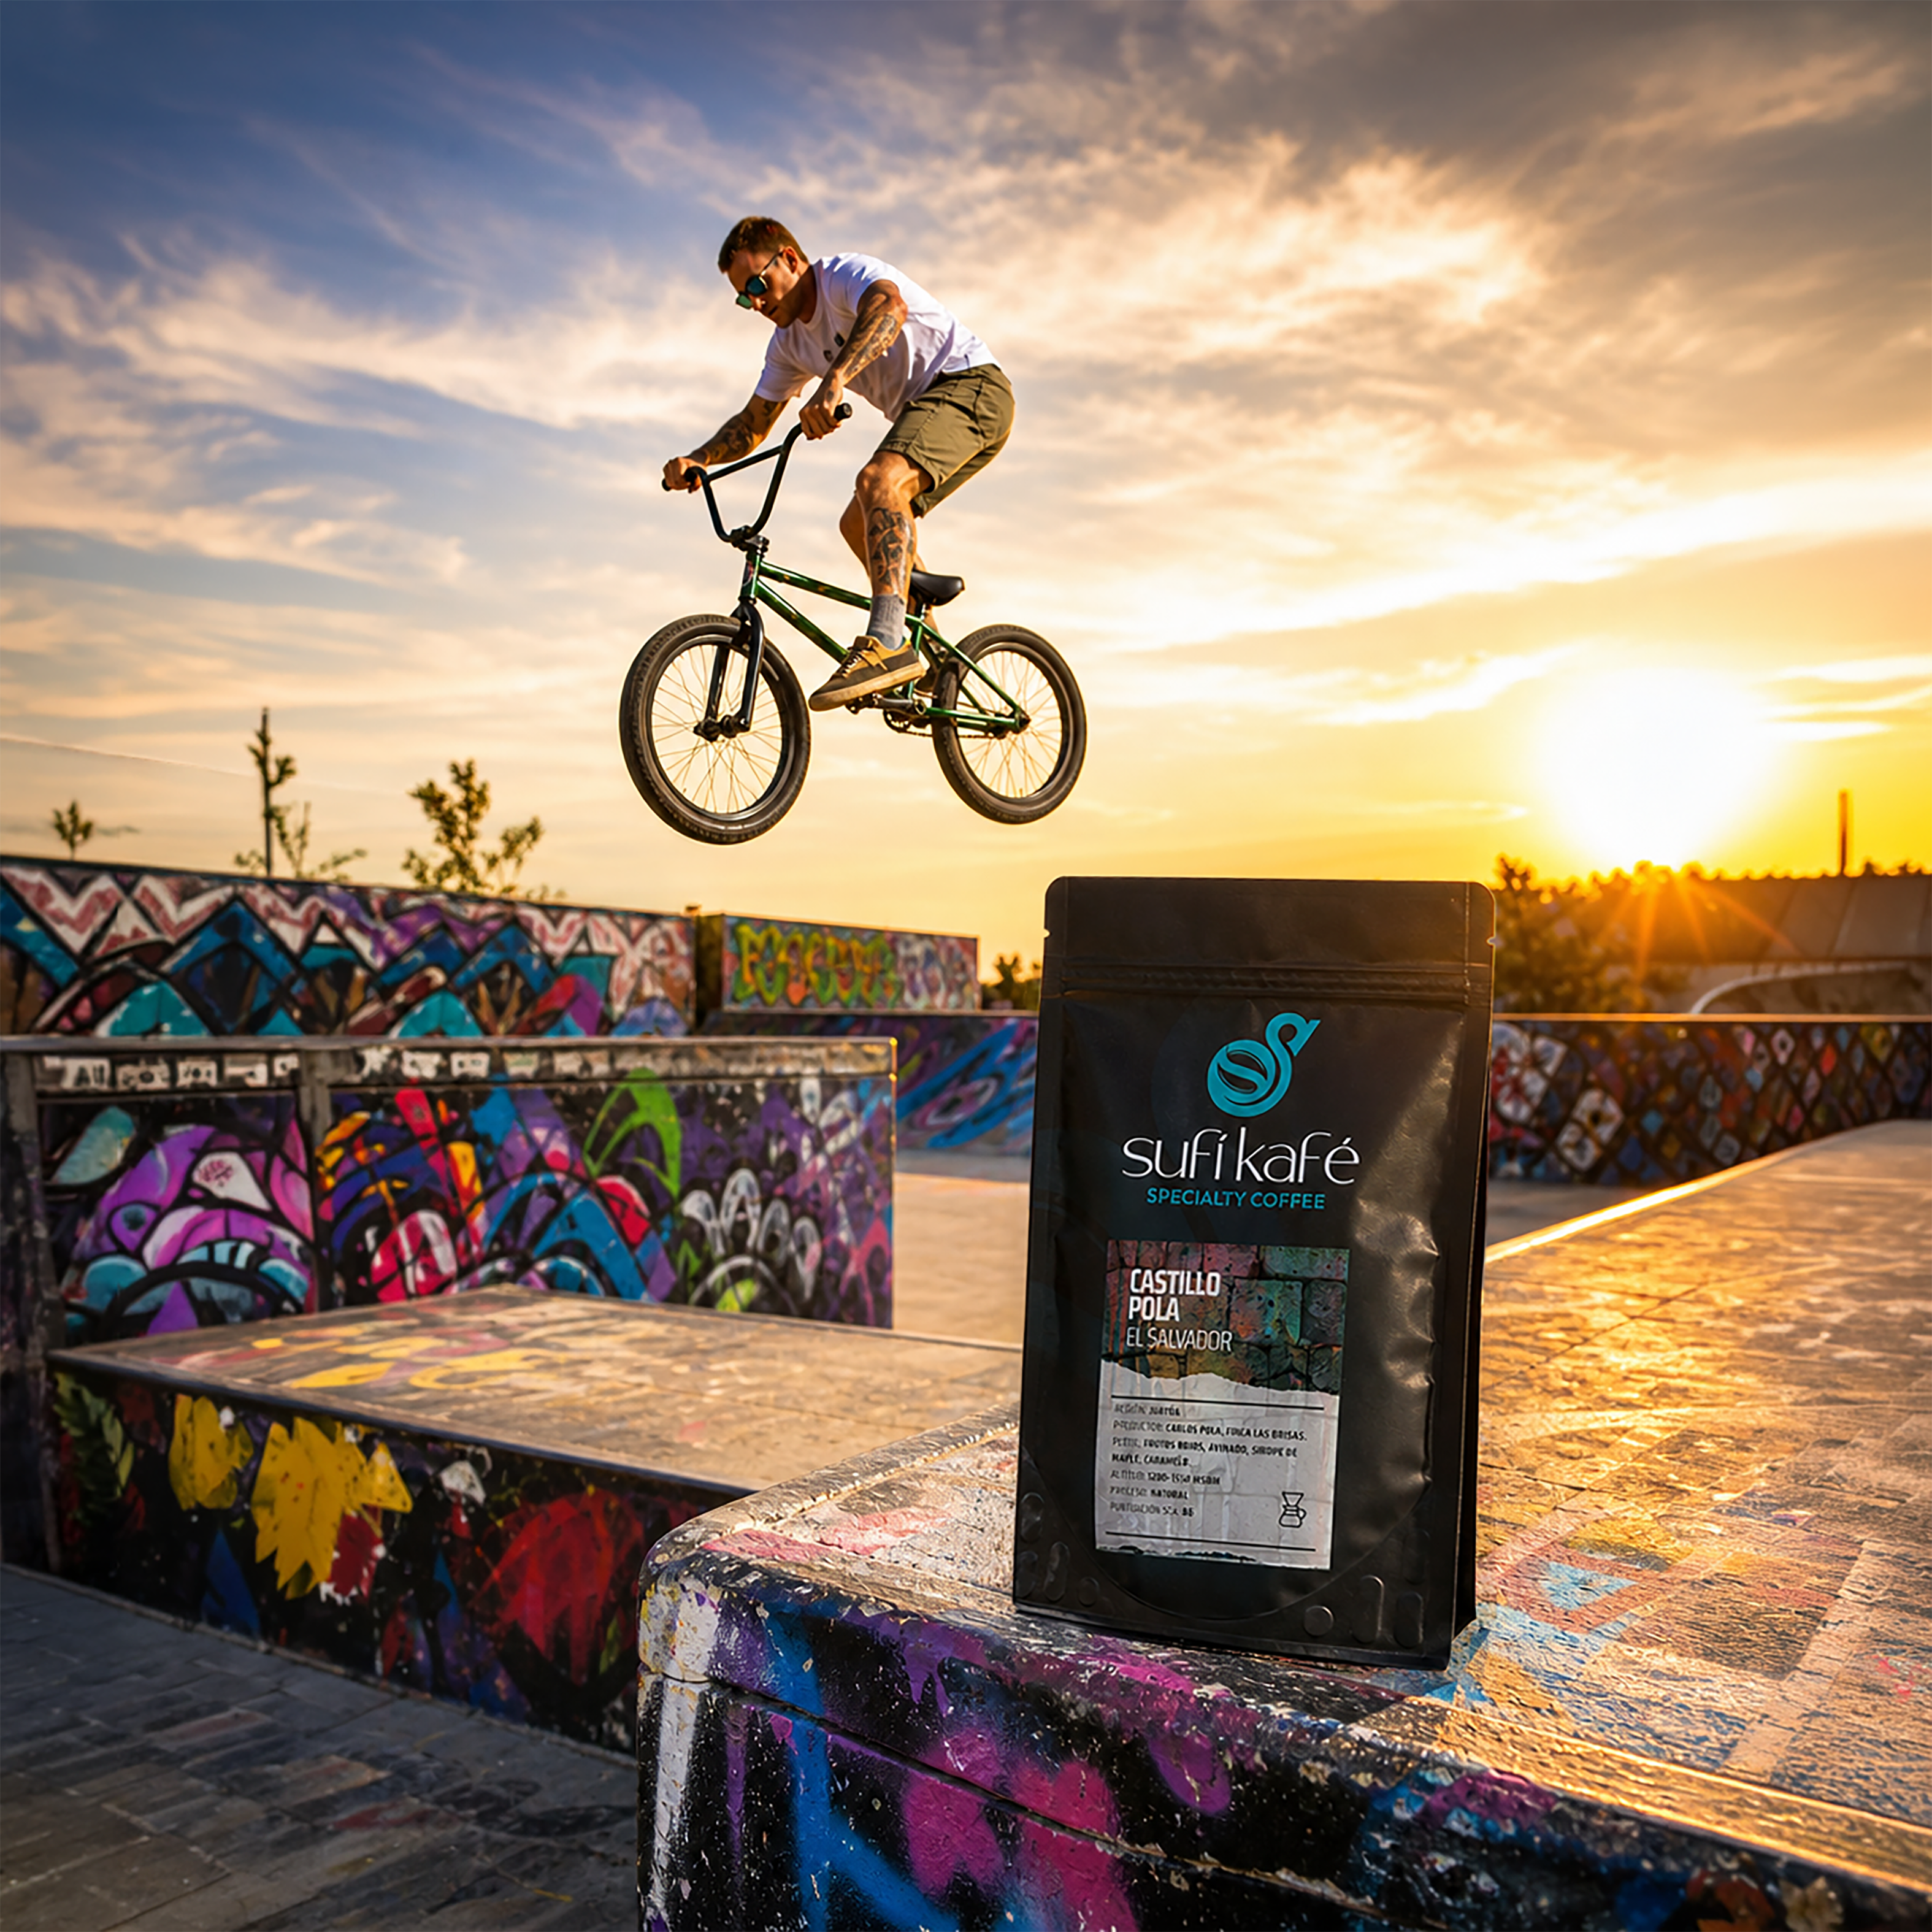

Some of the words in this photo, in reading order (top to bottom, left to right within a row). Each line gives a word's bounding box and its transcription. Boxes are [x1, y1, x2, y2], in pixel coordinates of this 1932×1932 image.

[1122, 1129, 1228, 1180] sufí
[1235, 1127, 1360, 1184] kafé
[1146, 1187, 1247, 1207] SPECIALTY
[1250, 1192, 1325, 1209] COFFEE
[1130, 1268, 1221, 1297] CASTILLO
[1129, 1295, 1180, 1322] POLA
[1126, 1327, 1143, 1347] EL
[1148, 1327, 1233, 1351] SALVADOR
